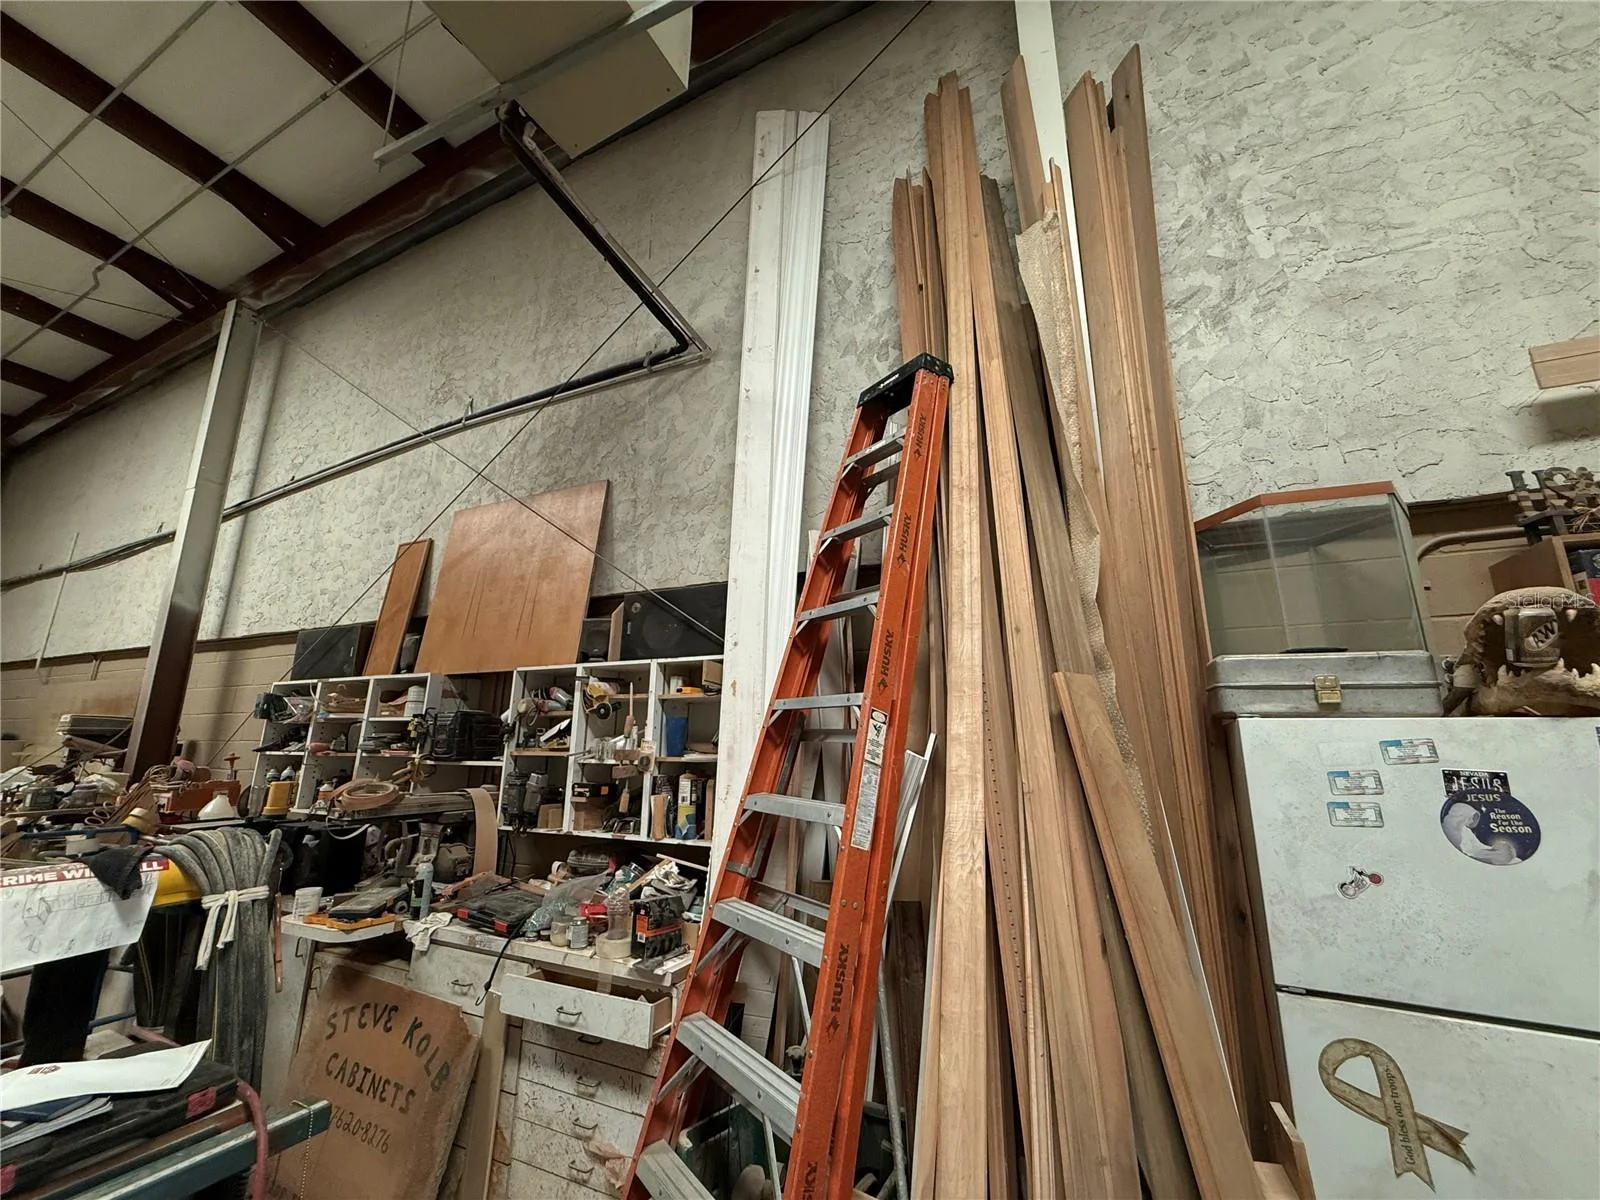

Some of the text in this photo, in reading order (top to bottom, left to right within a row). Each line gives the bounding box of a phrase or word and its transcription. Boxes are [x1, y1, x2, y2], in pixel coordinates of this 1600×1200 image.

[915, 412, 927, 449] HUSKY
[899, 512, 911, 552] HUSKY
[881, 629, 894, 676] HUSKY
[1466, 793, 1501, 802] JESUS
[1489, 812, 1521, 820] Reason
[1489, 823, 1532, 833] Season
[0, 871, 57, 886] RIME
[831, 944, 849, 1012] HUSKY
[325, 1002, 450, 1092] STEVE KOLB
[325, 1052, 416, 1114] CABINETS
[1393, 1099, 1404, 1118] our
[1399, 1119, 1410, 1143] bless
[1401, 1145, 1416, 1165] God
